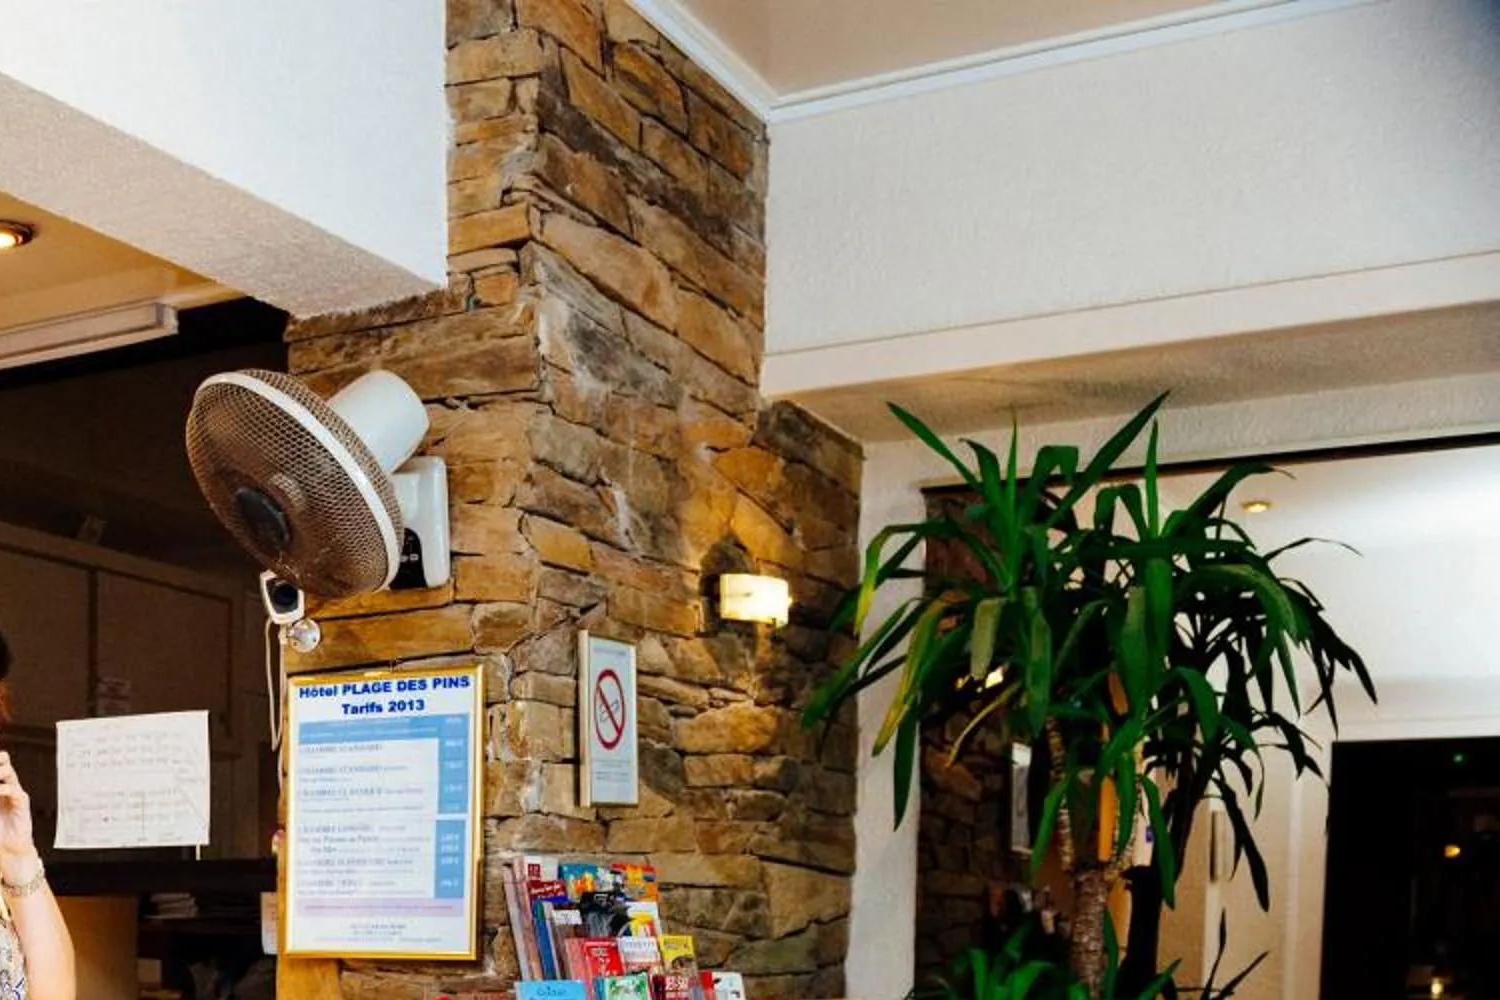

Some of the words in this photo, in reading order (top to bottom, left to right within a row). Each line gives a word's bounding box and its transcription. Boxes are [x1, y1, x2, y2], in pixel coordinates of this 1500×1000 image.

[299, 685, 338, 698] Hôtel
[342, 681, 391, 697] PLAGE
[397, 678, 427, 692] DES
[432, 676, 470, 690] PINS
[341, 700, 384, 715] Tarifs
[387, 699, 425, 713] 2013
